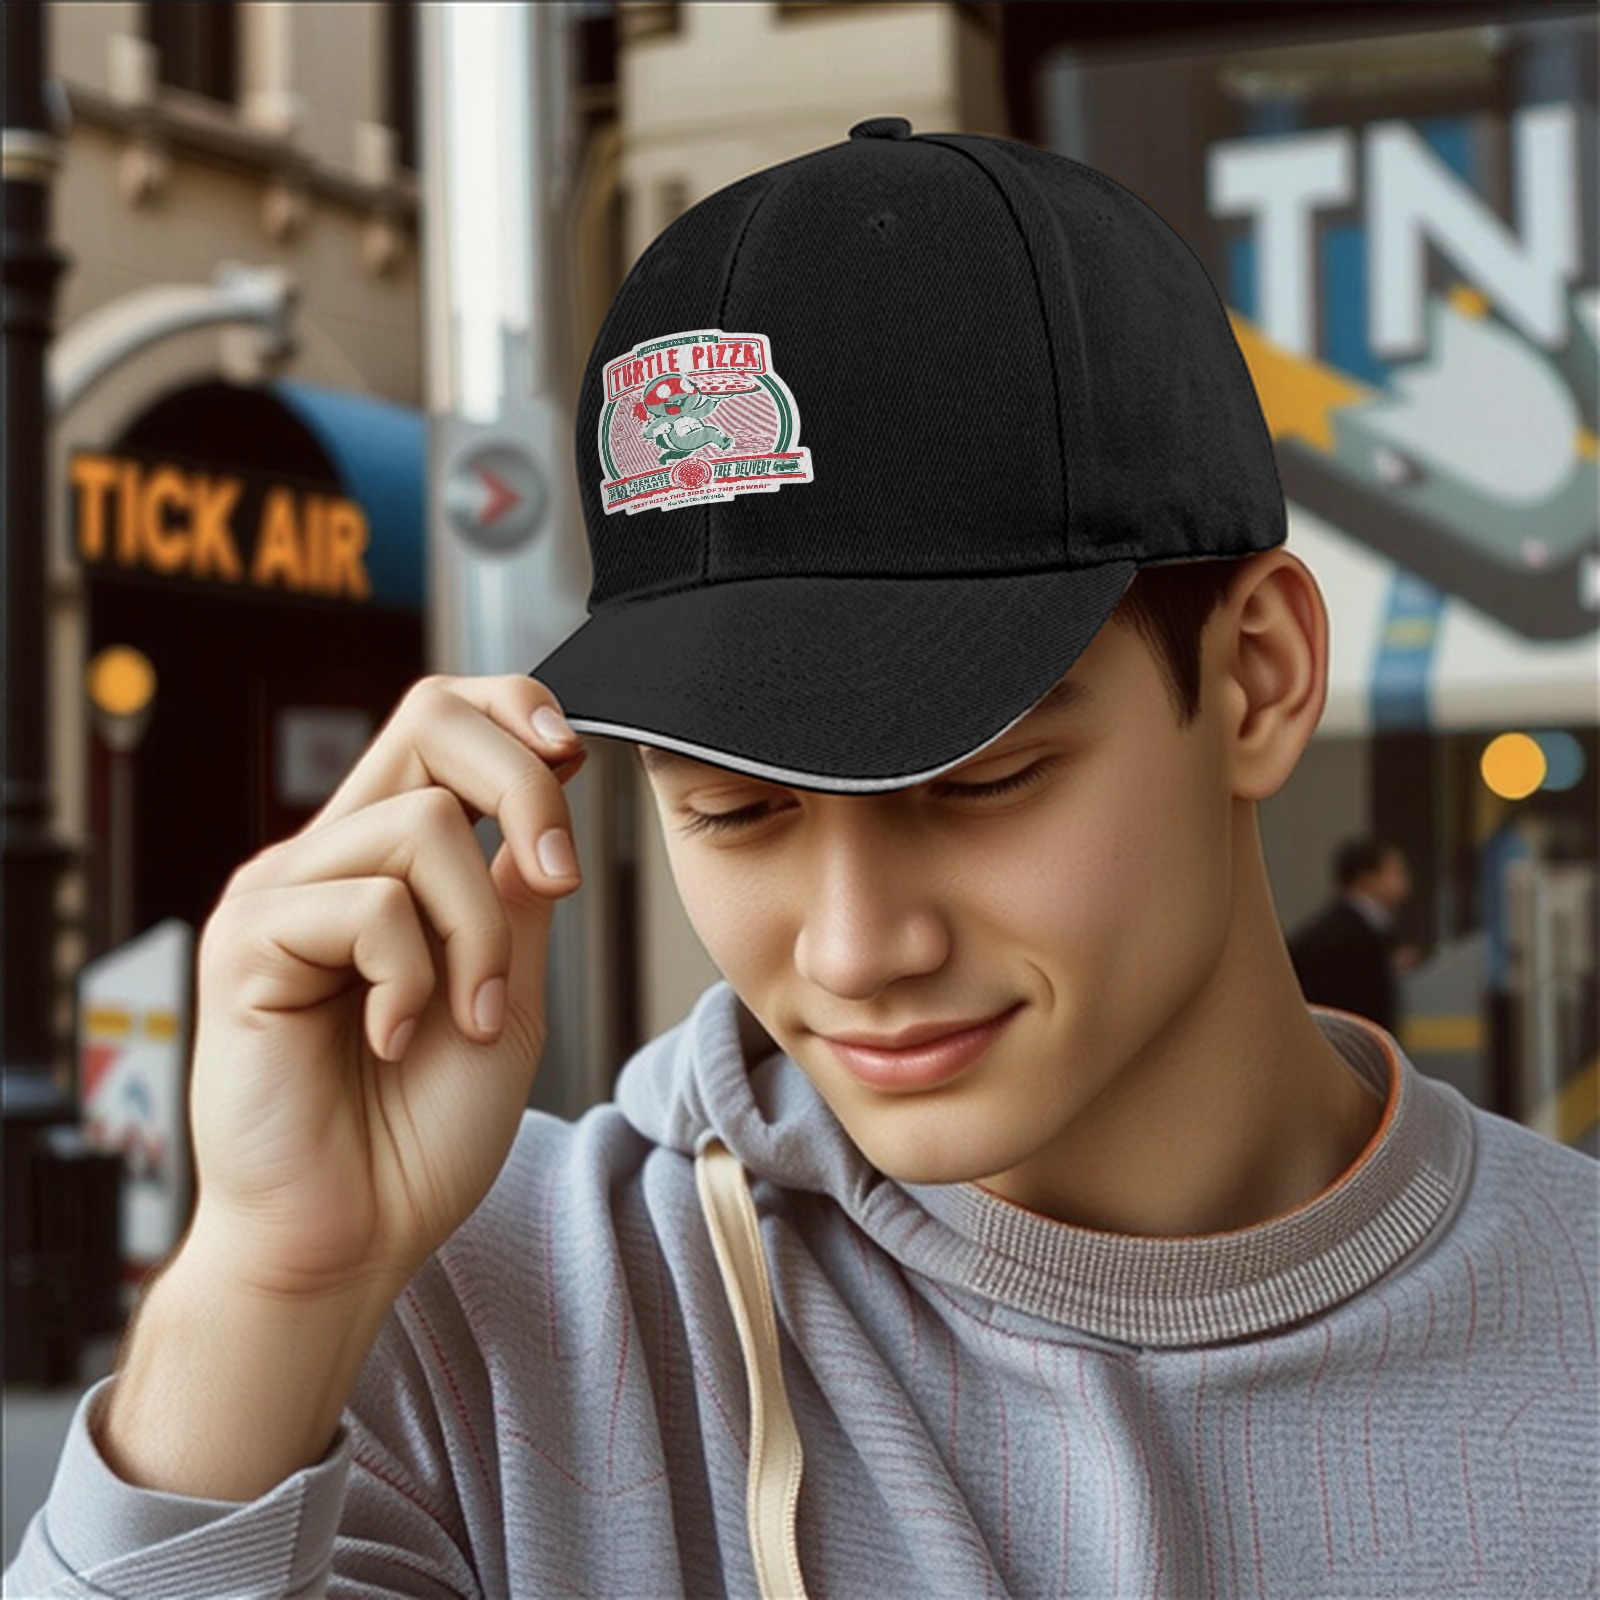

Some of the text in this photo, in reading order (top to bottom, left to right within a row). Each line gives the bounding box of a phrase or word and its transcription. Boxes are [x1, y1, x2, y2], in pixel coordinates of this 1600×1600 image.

[611, 342, 757, 392] TURTLE PIZZA
[713, 463, 732, 477] FREE
[735, 460, 772, 477] DELIVERY
[628, 474, 670, 488] TEENAGE
[629, 480, 670, 495] MUTANTS
[650, 497, 669, 505] PIZZA
[670, 492, 688, 500] THIS
[688, 489, 705, 497] SIDE
[250, 484, 373, 600] AIR
